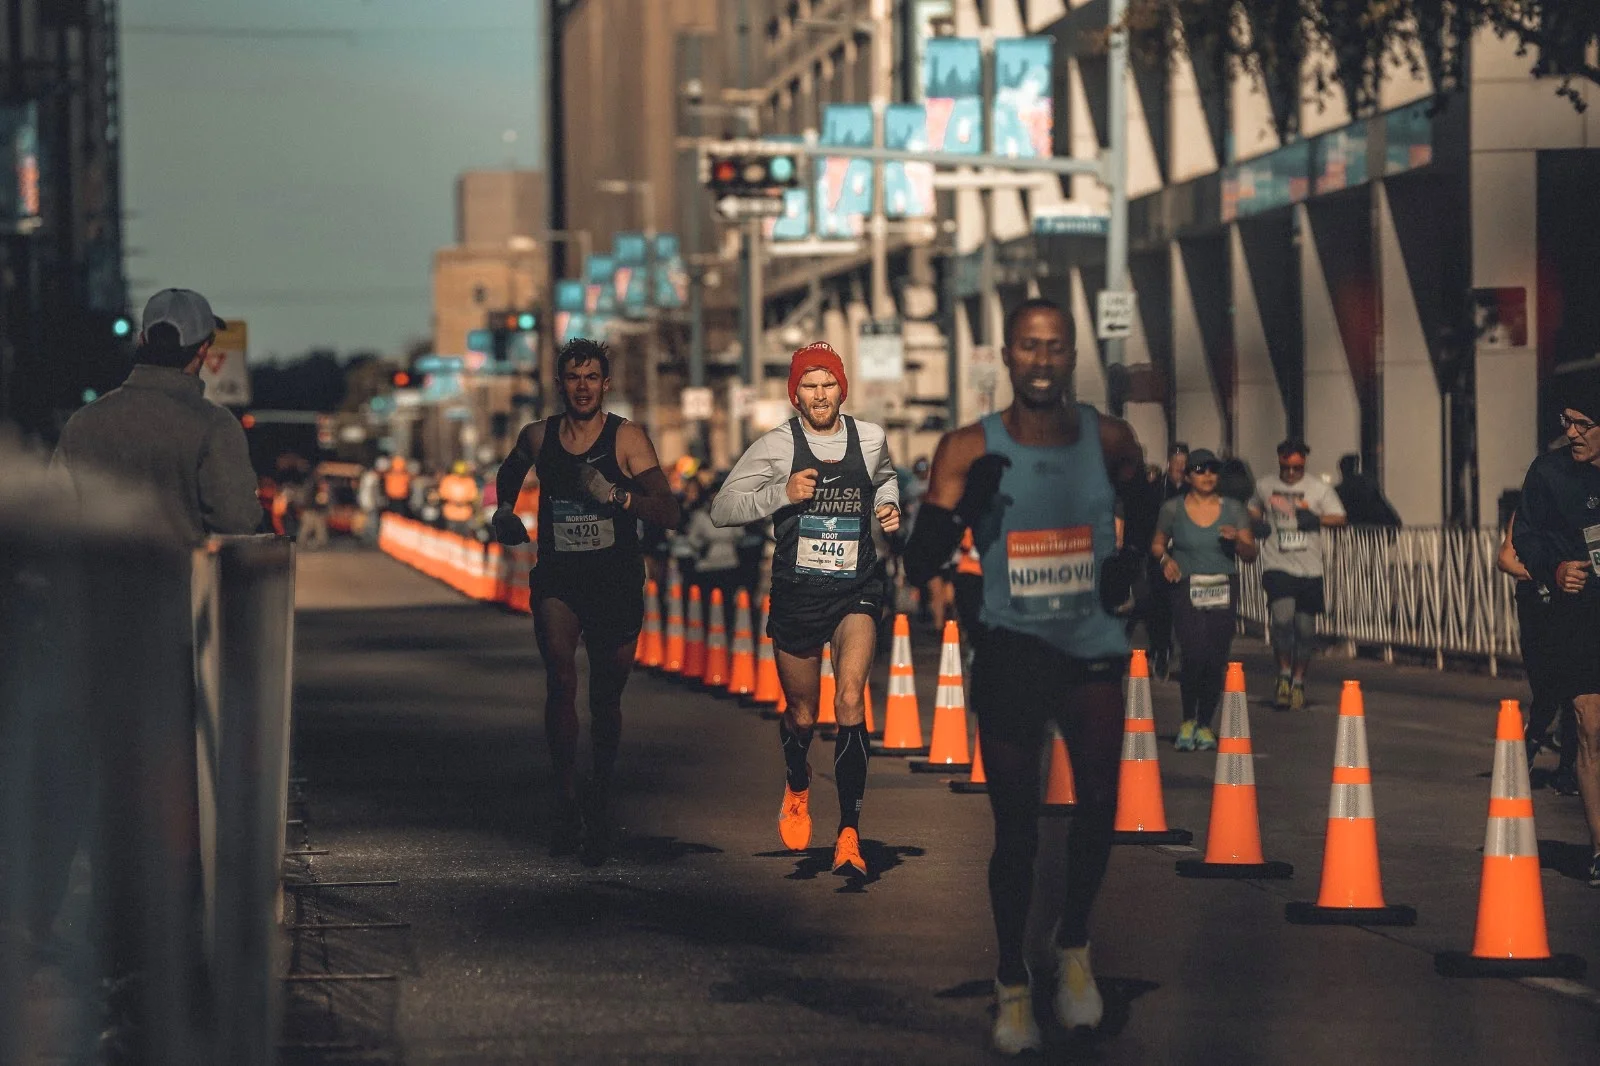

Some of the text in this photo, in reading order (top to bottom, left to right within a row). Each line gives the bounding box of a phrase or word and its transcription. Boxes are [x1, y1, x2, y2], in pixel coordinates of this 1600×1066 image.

[815, 488, 860, 500] TULSA
[805, 501, 861, 512] UNNER
[566, 514, 598, 522] MORRISON
[574, 524, 599, 537] 420
[819, 542, 844, 556] 446
